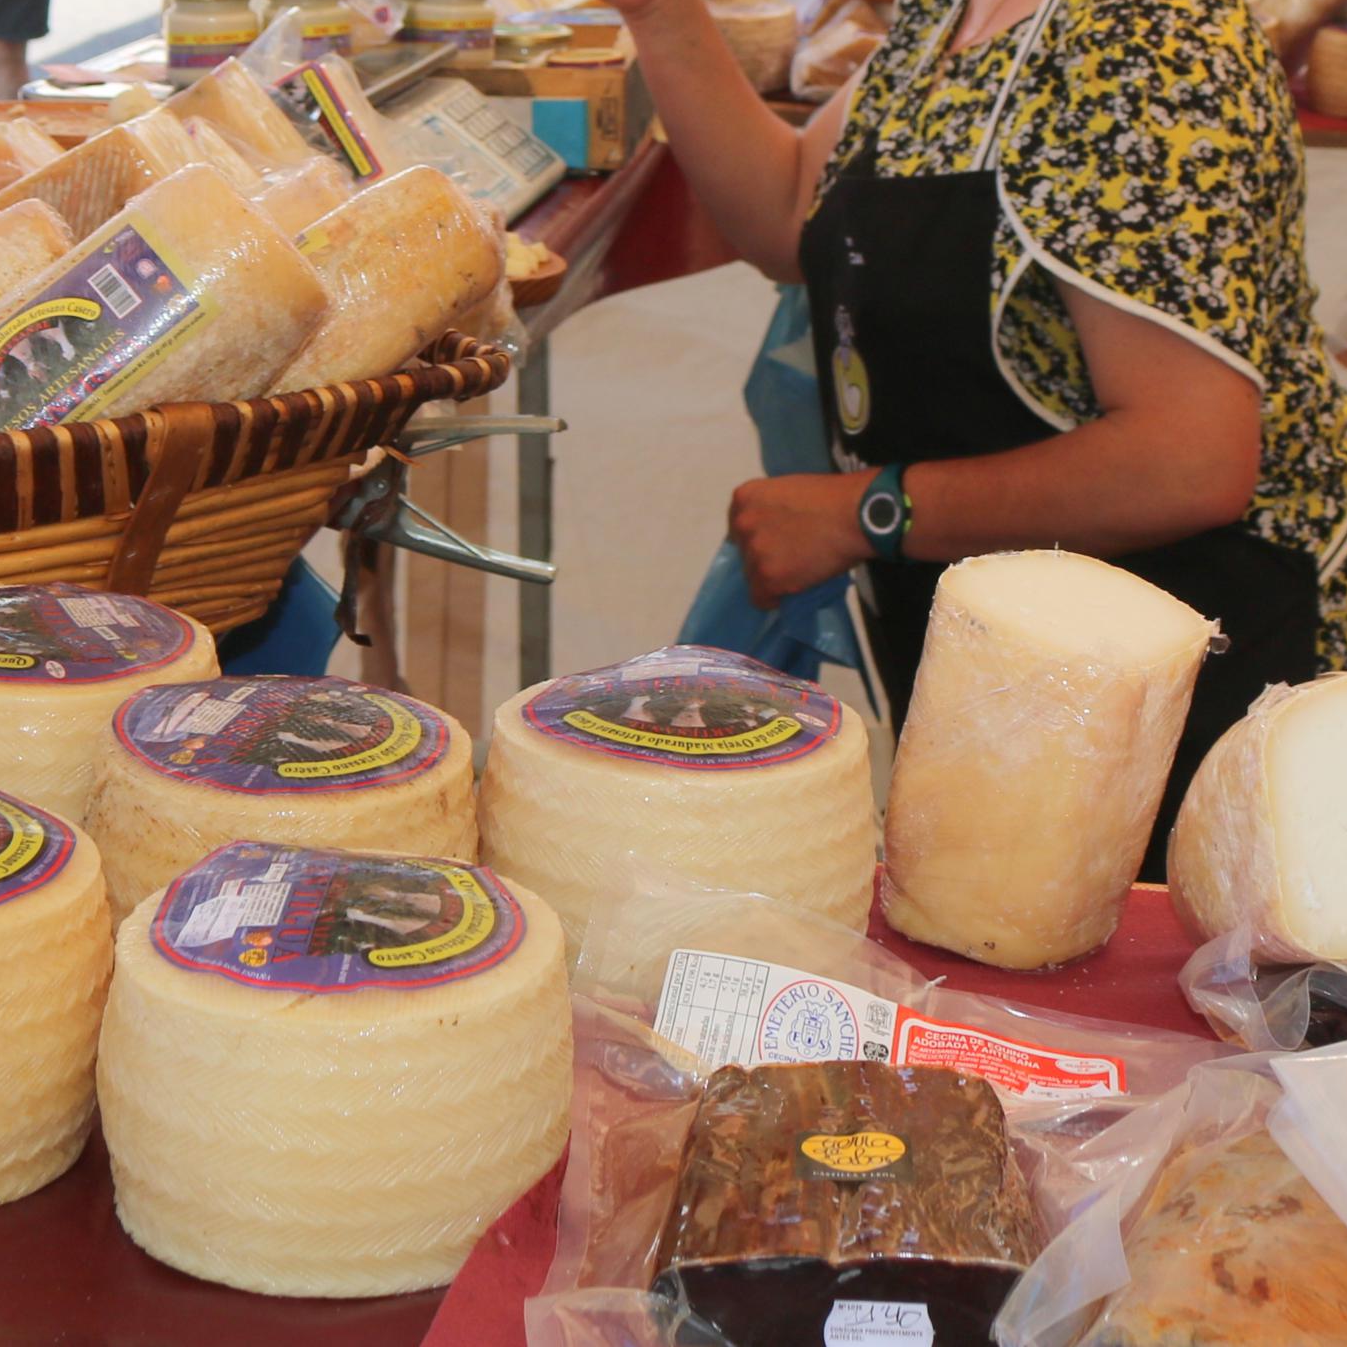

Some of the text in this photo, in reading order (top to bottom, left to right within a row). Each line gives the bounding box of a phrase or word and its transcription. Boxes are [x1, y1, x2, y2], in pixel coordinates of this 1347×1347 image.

[66, 302, 98, 318] Casero
[35, 327, 129, 405] ARTESANALES
[766, 719, 796, 738] Queso
[648, 737, 715, 751] Madurado
[718, 738, 754, 751] Oveja
[753, 734, 767, 745] de
[283, 766, 331, 777] Casero
[375, 948, 426, 963] Casero
[764, 983, 856, 1061] EMETERIO SANCHE
[913, 1036, 970, 1051] ADOBADA
[970, 1044, 981, 1052] Y
[981, 1046, 1041, 1070] ARTESANA
[924, 1031, 968, 1043] CECINA
[969, 1036, 986, 1047] DE
[987, 1041, 1030, 1061] EQUINO
